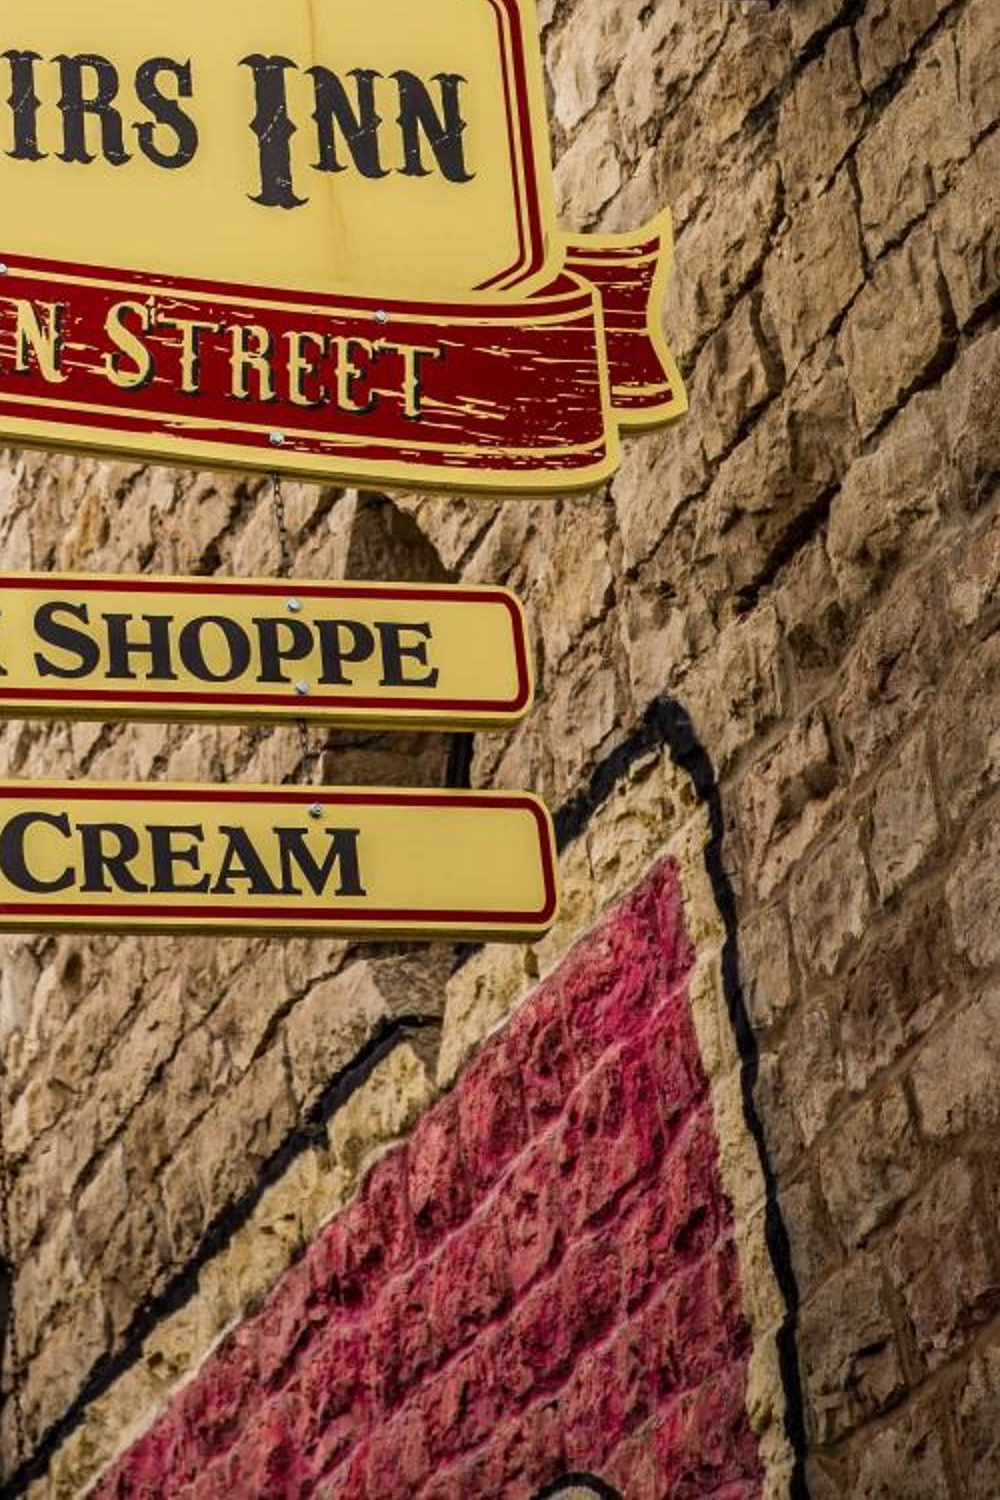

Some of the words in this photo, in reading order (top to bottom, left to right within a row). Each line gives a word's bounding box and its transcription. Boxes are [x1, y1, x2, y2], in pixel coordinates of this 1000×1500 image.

[238, 53, 476, 209] INN
[103, 295, 443, 422] STREET
[33, 600, 440, 688] SHOPPE
